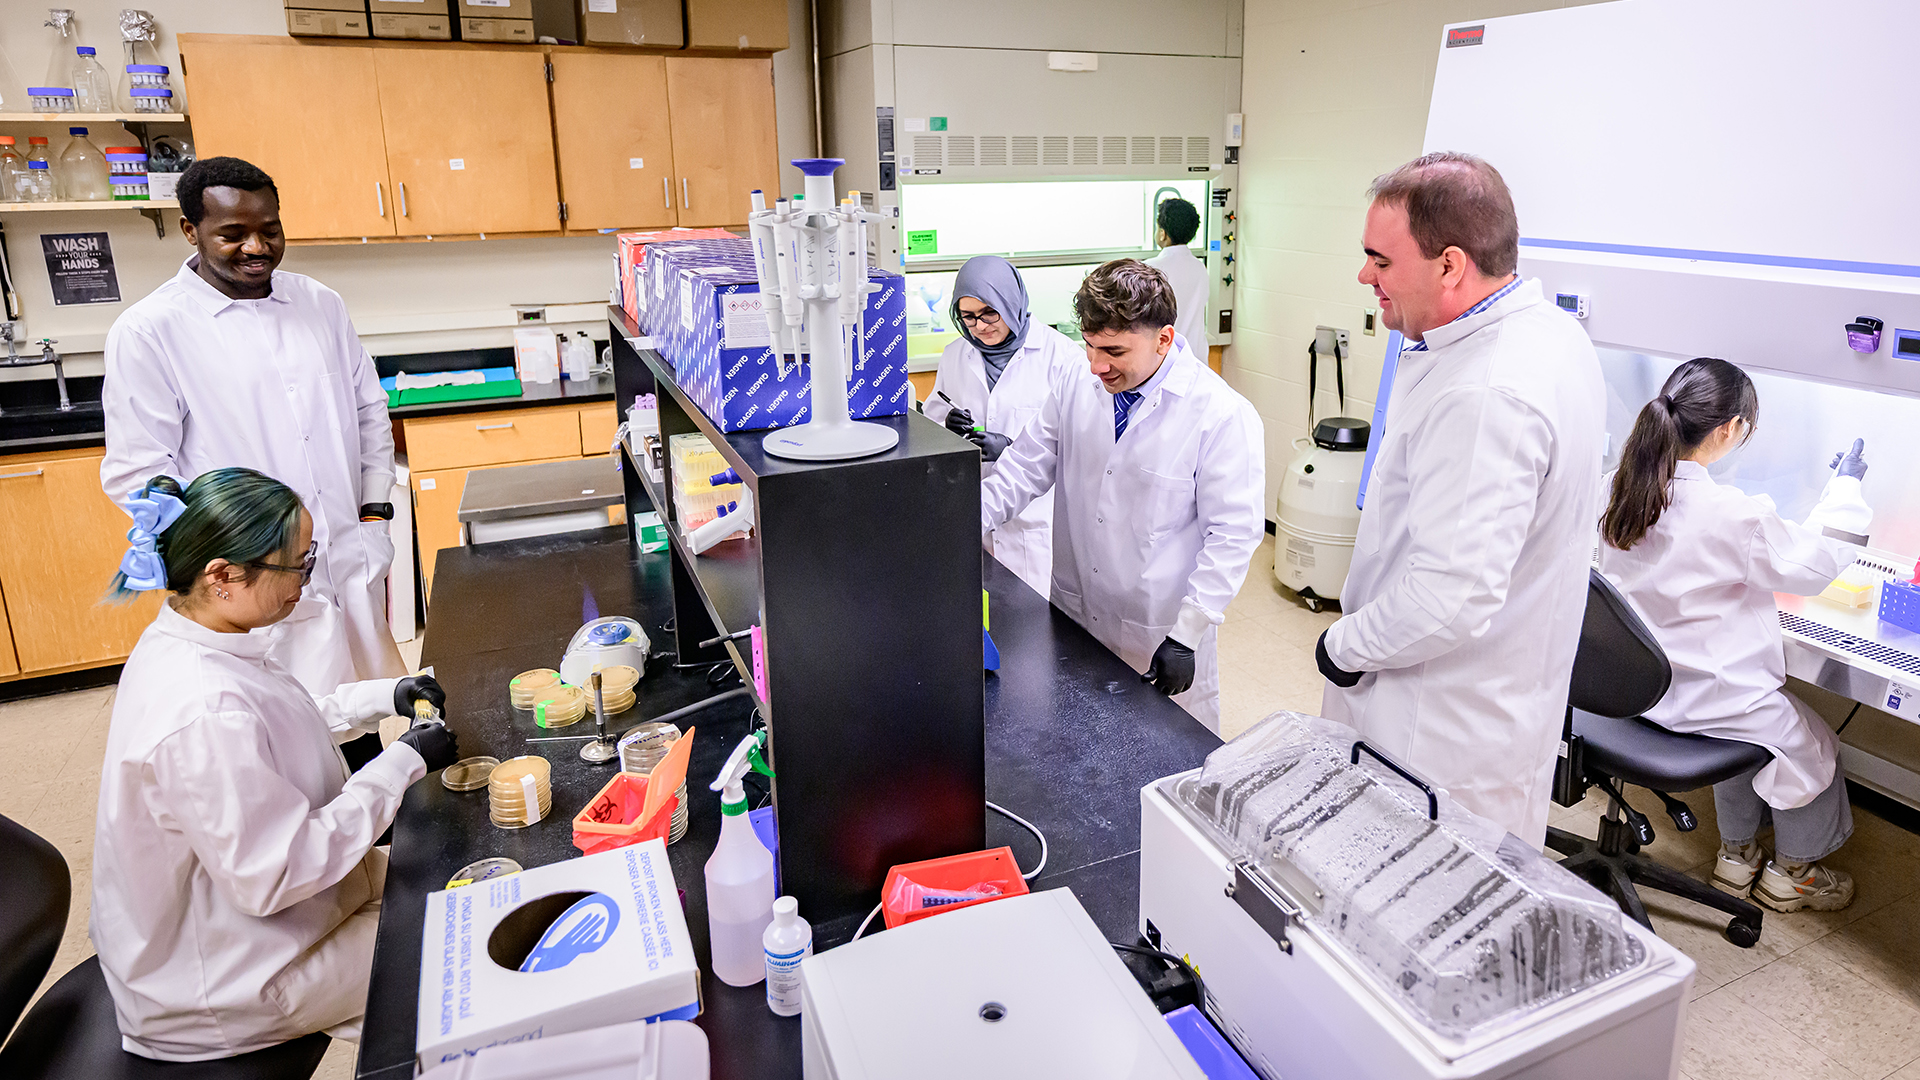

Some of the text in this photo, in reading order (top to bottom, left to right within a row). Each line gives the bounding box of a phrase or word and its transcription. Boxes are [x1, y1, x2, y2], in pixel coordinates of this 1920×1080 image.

[1449, 29, 1483, 40] Thermo
[52, 237, 99, 252] WASH
[68, 251, 89, 259] YOUR
[61, 258, 100, 270] HANDS
[874, 286, 896, 310] QIAGEN
[864, 317, 885, 341] QIAGEN
[892, 308, 907, 327] QIAG
[757, 346, 773, 366] QIAG
[882, 334, 903, 358] QIAGEN
[725, 355, 749, 380] QIAGEN
[854, 347, 876, 371] QGEN
[777, 362, 797, 382] QAGE
[872, 363, 894, 388] QIAGEN
[746, 372, 769, 397] QIAGEN
[796, 379, 812, 399] QIAG
[719, 386, 739, 410] AGEN
[766, 389, 789, 414] QIAGEN
[862, 394, 883, 418] QIAGEN
[736, 403, 759, 428] QIAGEN
[787, 406, 808, 427] QIAGE
[624, 849, 659, 971] DÉPOSER LA VERRERIE CASSÉE ICI
[640, 851, 673, 958] DEPOSIT BROKEN GLASS HERE
[440, 891, 457, 1036] GEBROCHENES GLAS HIER ABLAGERN
[459, 895, 475, 1020] PONGA SU CRISTAL ROTO AQUÍ
